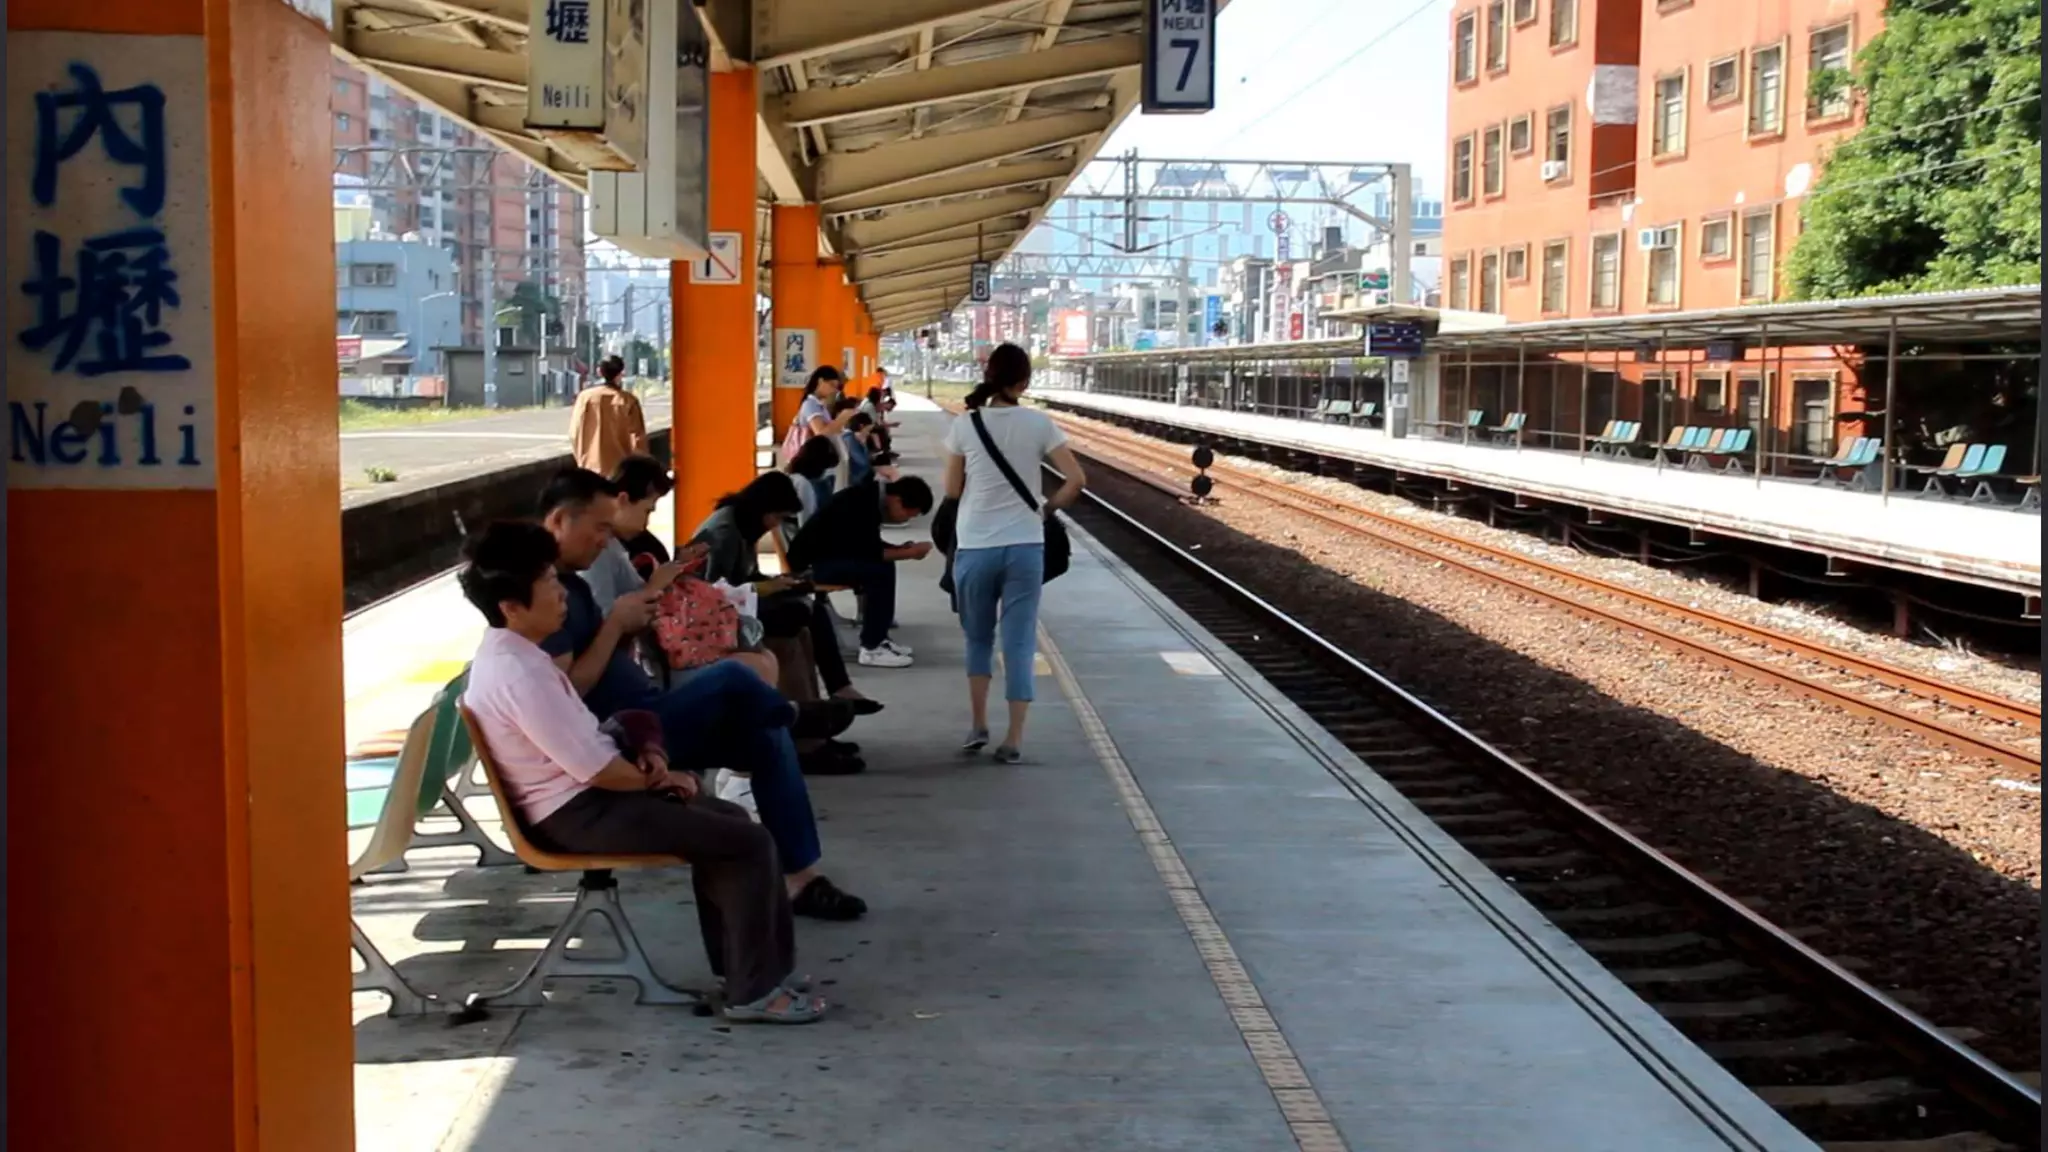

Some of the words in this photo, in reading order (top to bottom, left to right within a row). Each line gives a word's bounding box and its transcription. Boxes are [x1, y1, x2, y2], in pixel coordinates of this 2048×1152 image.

[546, 0, 589, 43] 壢
[1163, 17, 1204, 31] NEILI
[1170, 38, 1199, 92] 7
[543, 83, 589, 109] Neili
[18, 62, 191, 376] 內壢
[11, 402, 201, 466] Neili
